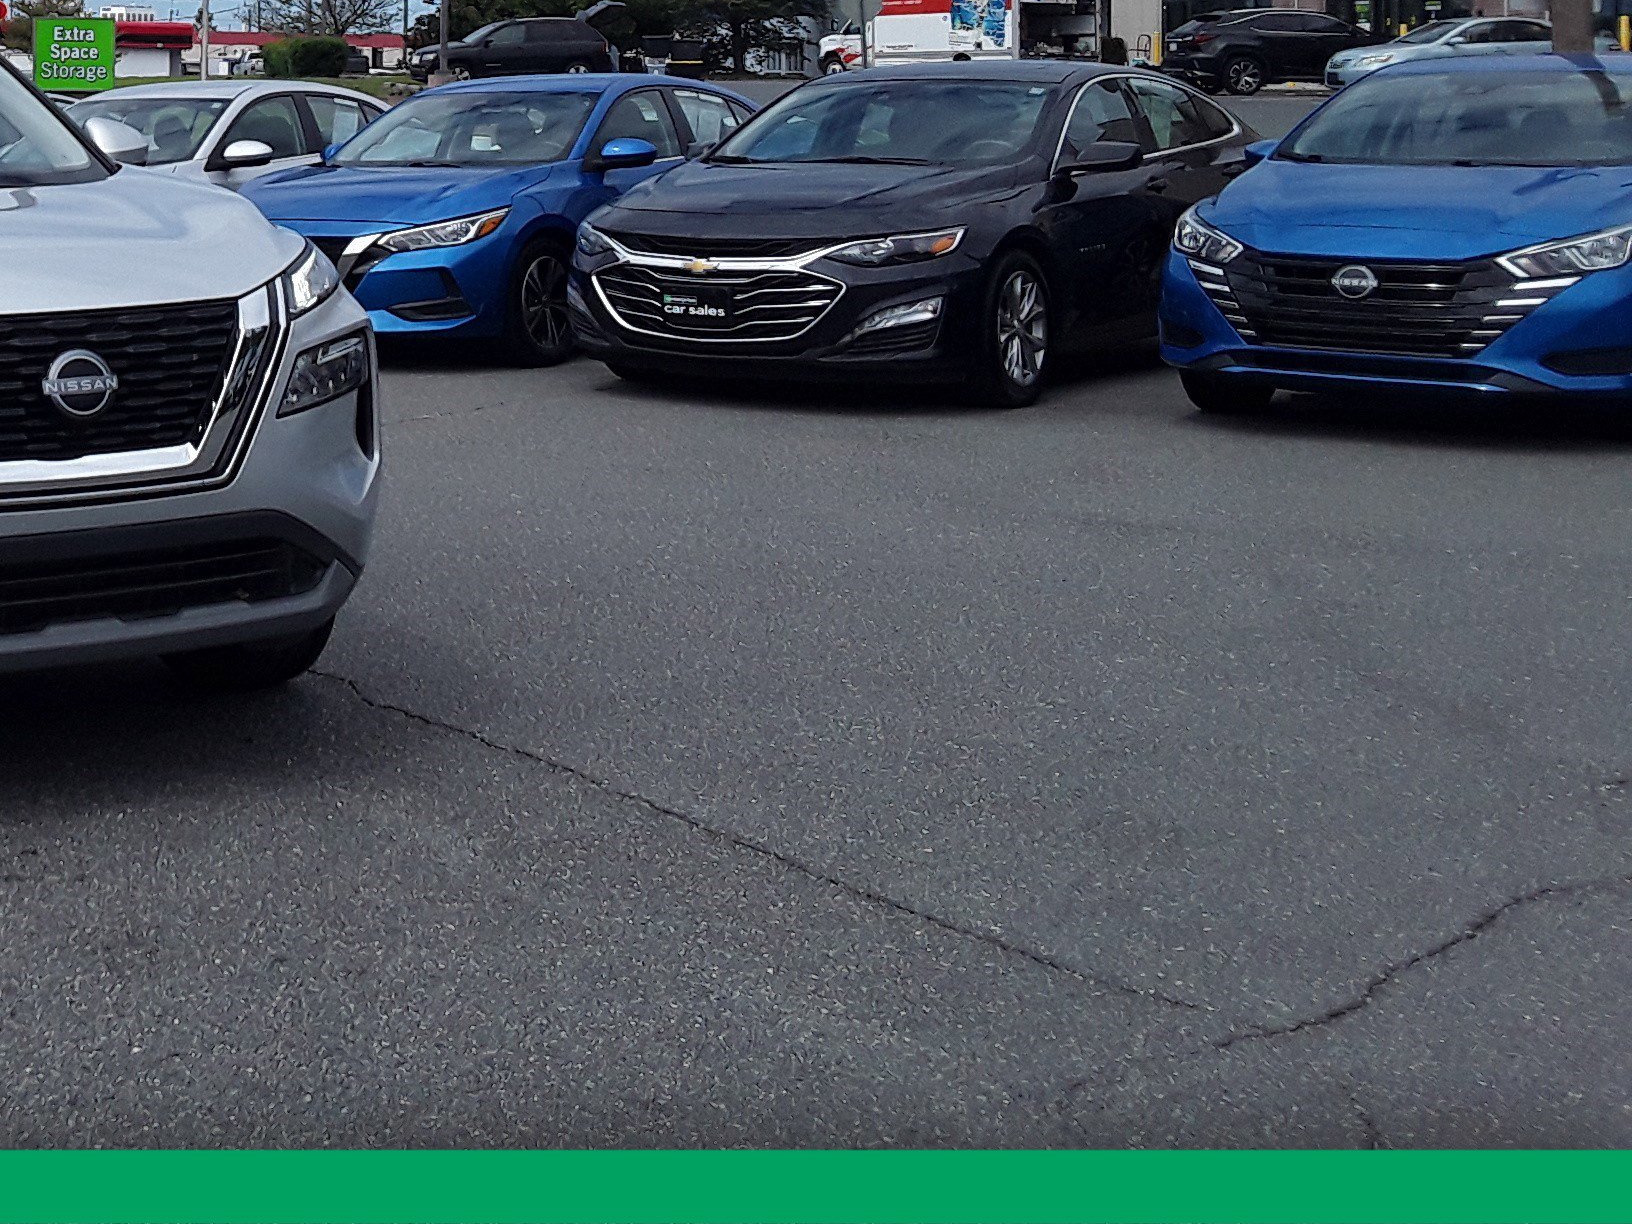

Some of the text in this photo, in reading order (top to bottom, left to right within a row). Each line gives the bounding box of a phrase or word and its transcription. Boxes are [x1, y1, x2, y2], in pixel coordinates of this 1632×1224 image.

[53, 26, 94, 41] Extra
[50, 43, 98, 62] Space
[41, 62, 106, 82] Storage
[664, 304, 725, 316] car sales
[45, 378, 117, 392] NISSAN
